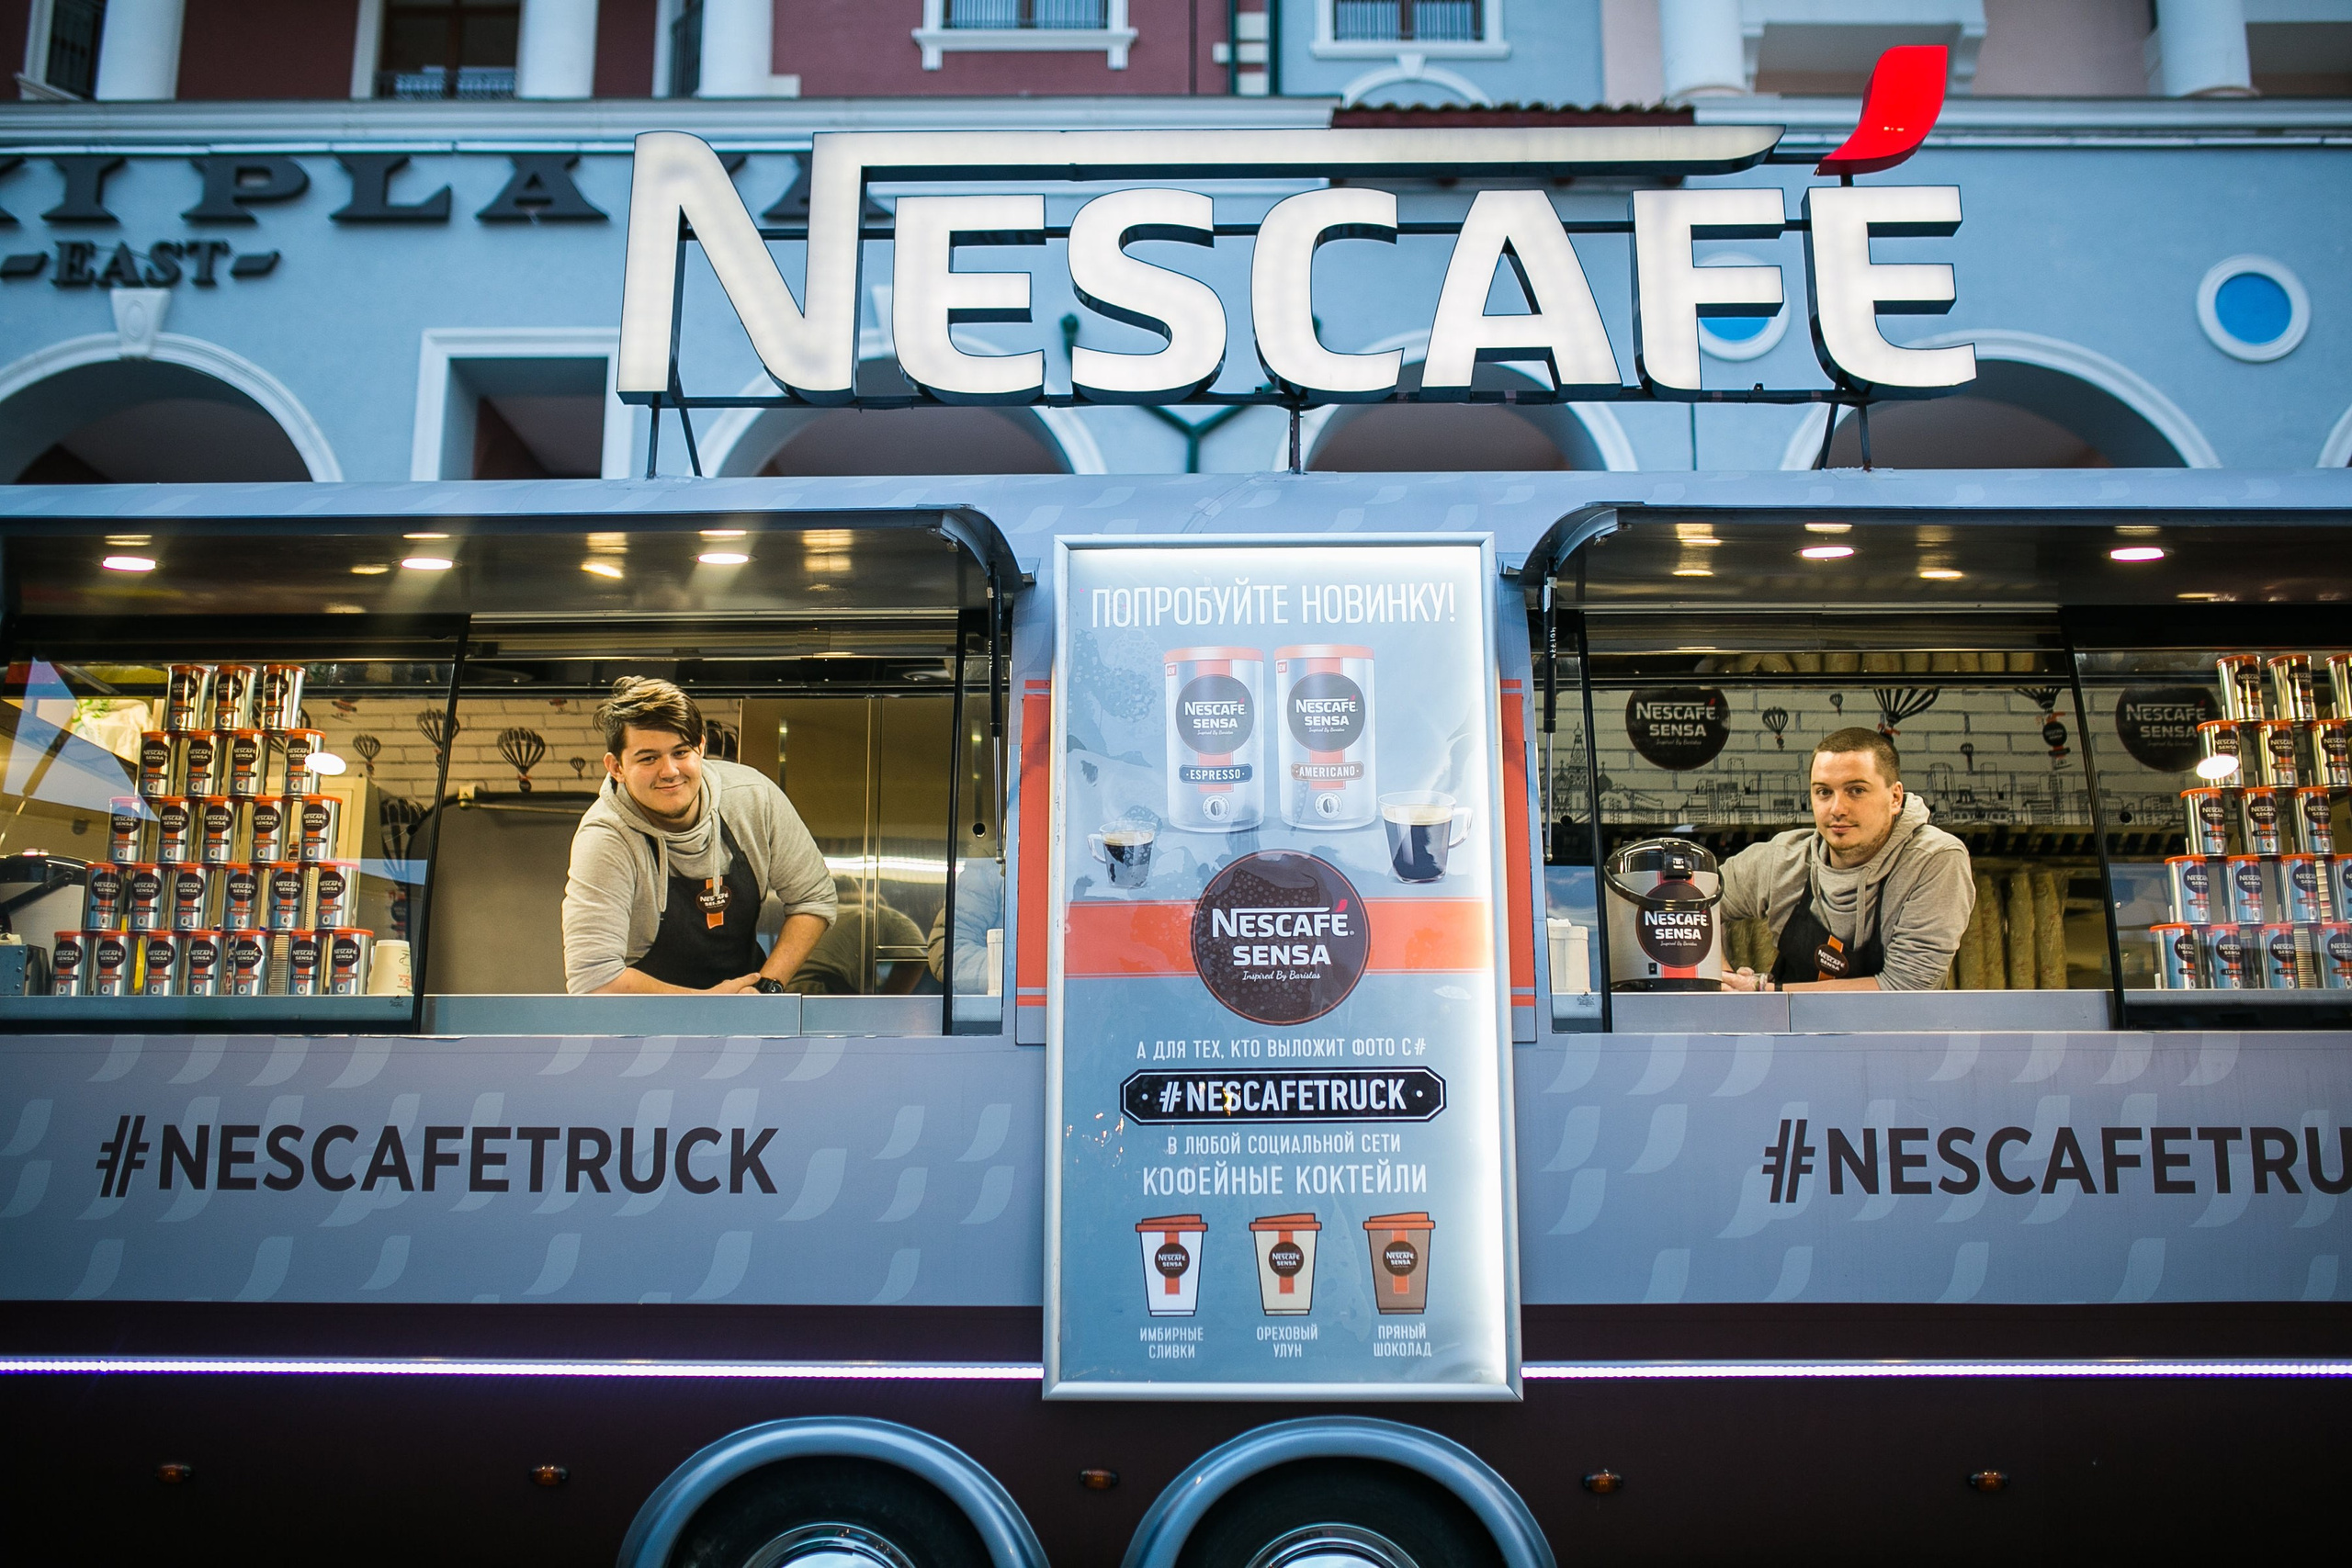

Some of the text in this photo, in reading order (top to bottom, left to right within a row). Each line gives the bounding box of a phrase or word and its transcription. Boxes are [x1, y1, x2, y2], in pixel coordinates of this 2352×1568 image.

[617, 45, 1977, 402] NESCAFÉ
[1091, 577, 1456, 628] ПОПРОБУЙТЕ НОВИНКУ!
[1193, 717, 1238, 728] SENSA
[1304, 715, 1350, 726] SENSA
[1649, 724, 1707, 737] SENSA
[2140, 725, 2198, 738] SENSA
[1190, 768, 1240, 780] ESPRESSO
[1299, 766, 1355, 777] AMERICANO
[1212, 899, 1349, 938] NESCAFÉ
[1655, 928, 1702, 940] SENSA
[1233, 944, 1331, 966] SENSA
[1136, 1041, 1147, 1059] А
[1153, 1040, 1186, 1061] ДЛЯ
[1193, 1040, 1225, 1059] ТЕХ,
[1231, 1039, 1261, 1058] КТО
[1267, 1038, 1345, 1057] ВЫЛОЖИТ
[1351, 1037, 1396, 1056] ФОТО
[1159, 1078, 1408, 1112] #NESCAFETRUCK
[1168, 1131, 1401, 1156] В ЛЮБОЙ СОЦИАЛЬНОЙ СЕТИ
[96, 1114, 779, 1198] #NESCAFETRUCK
[1761, 1118, 2352, 1203] #NESCAFETRU
[1143, 1158, 1427, 1196] КОФЕЙНЫЕ КОКТЕЙЛИ
[1139, 1326, 1204, 1342] ИМБИРНЫЕ
[1256, 1324, 1318, 1341] ОРЕХОВЫЙ
[1378, 1322, 1426, 1340] ПРЯНЫЙ
[1148, 1343, 1195, 1359] СЛИВКИ
[1272, 1343, 1302, 1358] УЛУН
[1374, 1342, 1432, 1358] ШОКОЛАД
